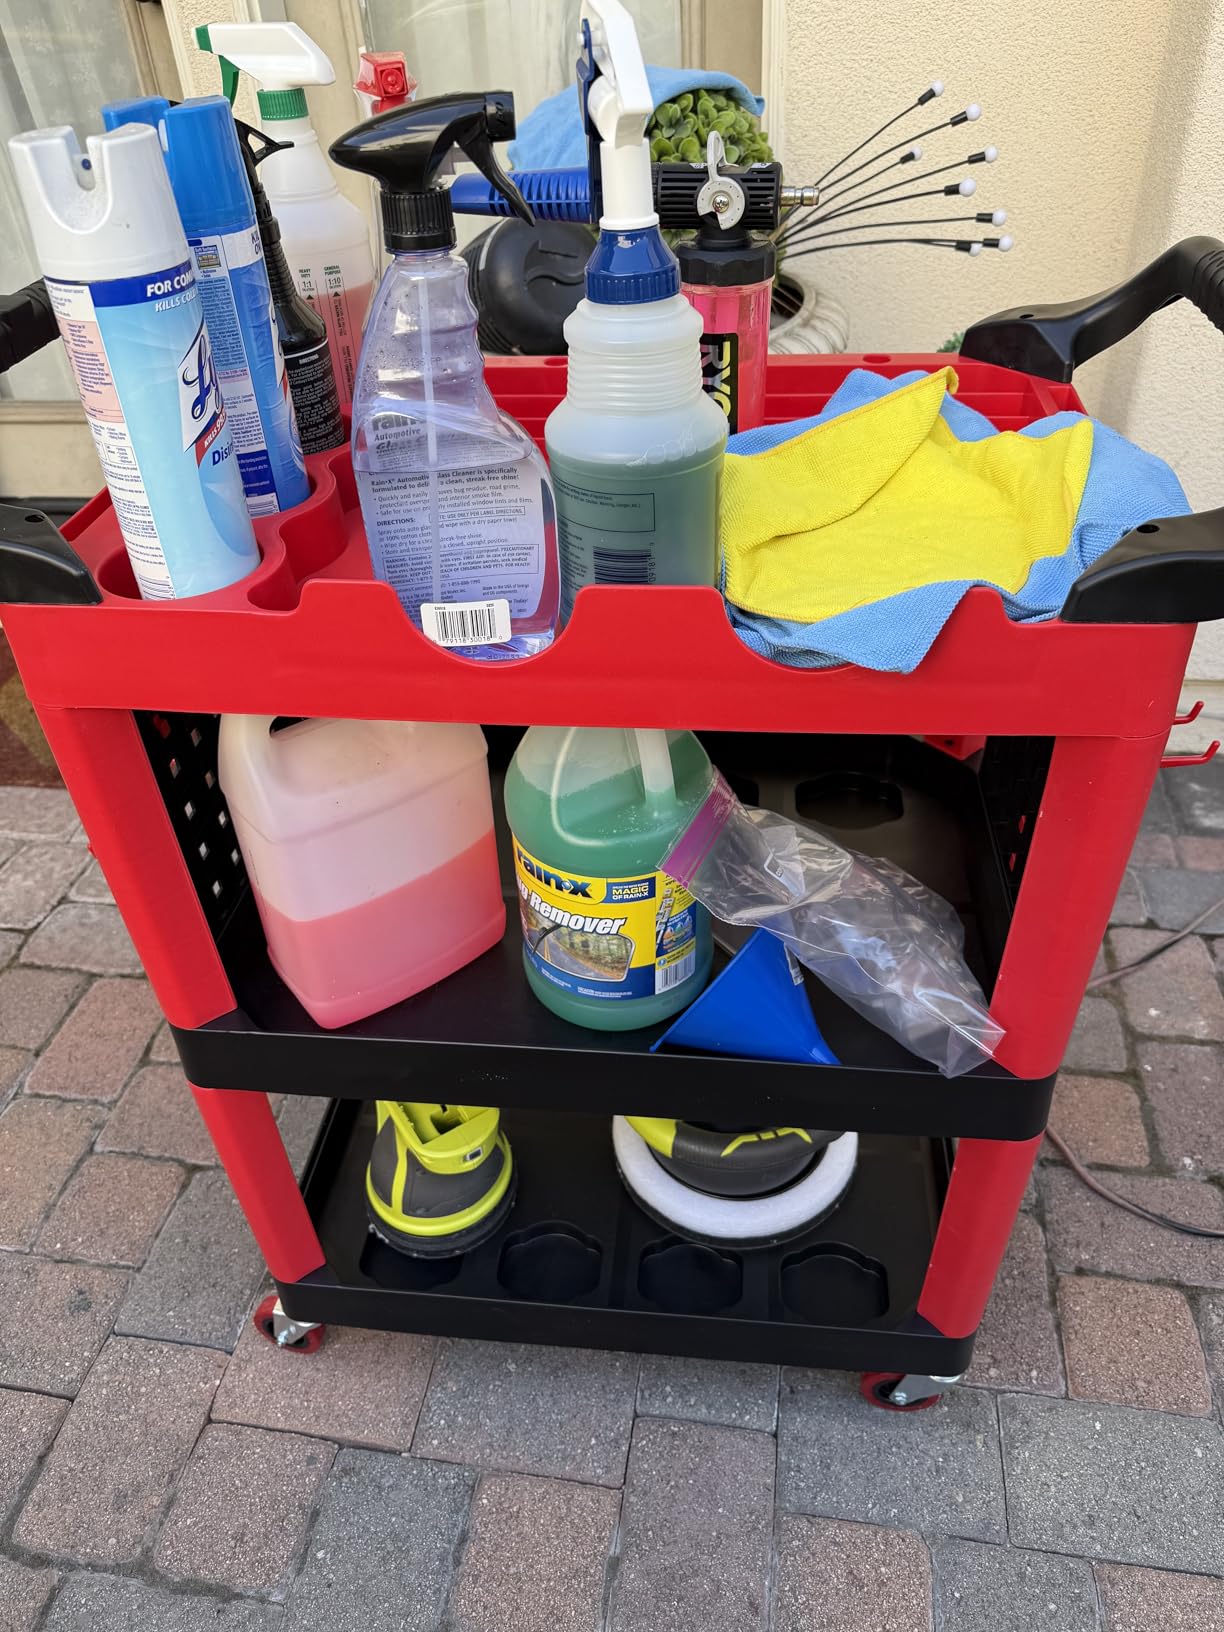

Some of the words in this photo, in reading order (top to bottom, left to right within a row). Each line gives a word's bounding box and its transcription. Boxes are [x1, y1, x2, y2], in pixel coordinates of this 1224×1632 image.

[302, 280, 312, 288] 1:1
[328, 277, 341, 286] 1:10
[146, 280, 172, 298] FOR
[154, 296, 180, 312] KILLS
[204, 429, 218, 448] KILLS
[374, 428, 421, 441] Automotive
[398, 474, 430, 482] Automotiv
[484, 466, 518, 474] specifically
[372, 484, 407, 493] formulated
[378, 494, 398, 502] Quickly
[377, 518, 416, 526] DIRECTIONS:
[421, 524, 431, 532] glas
[463, 558, 482, 566] irritation
[612, 885, 649, 895] MAGIC
[530, 891, 628, 935] Remover
